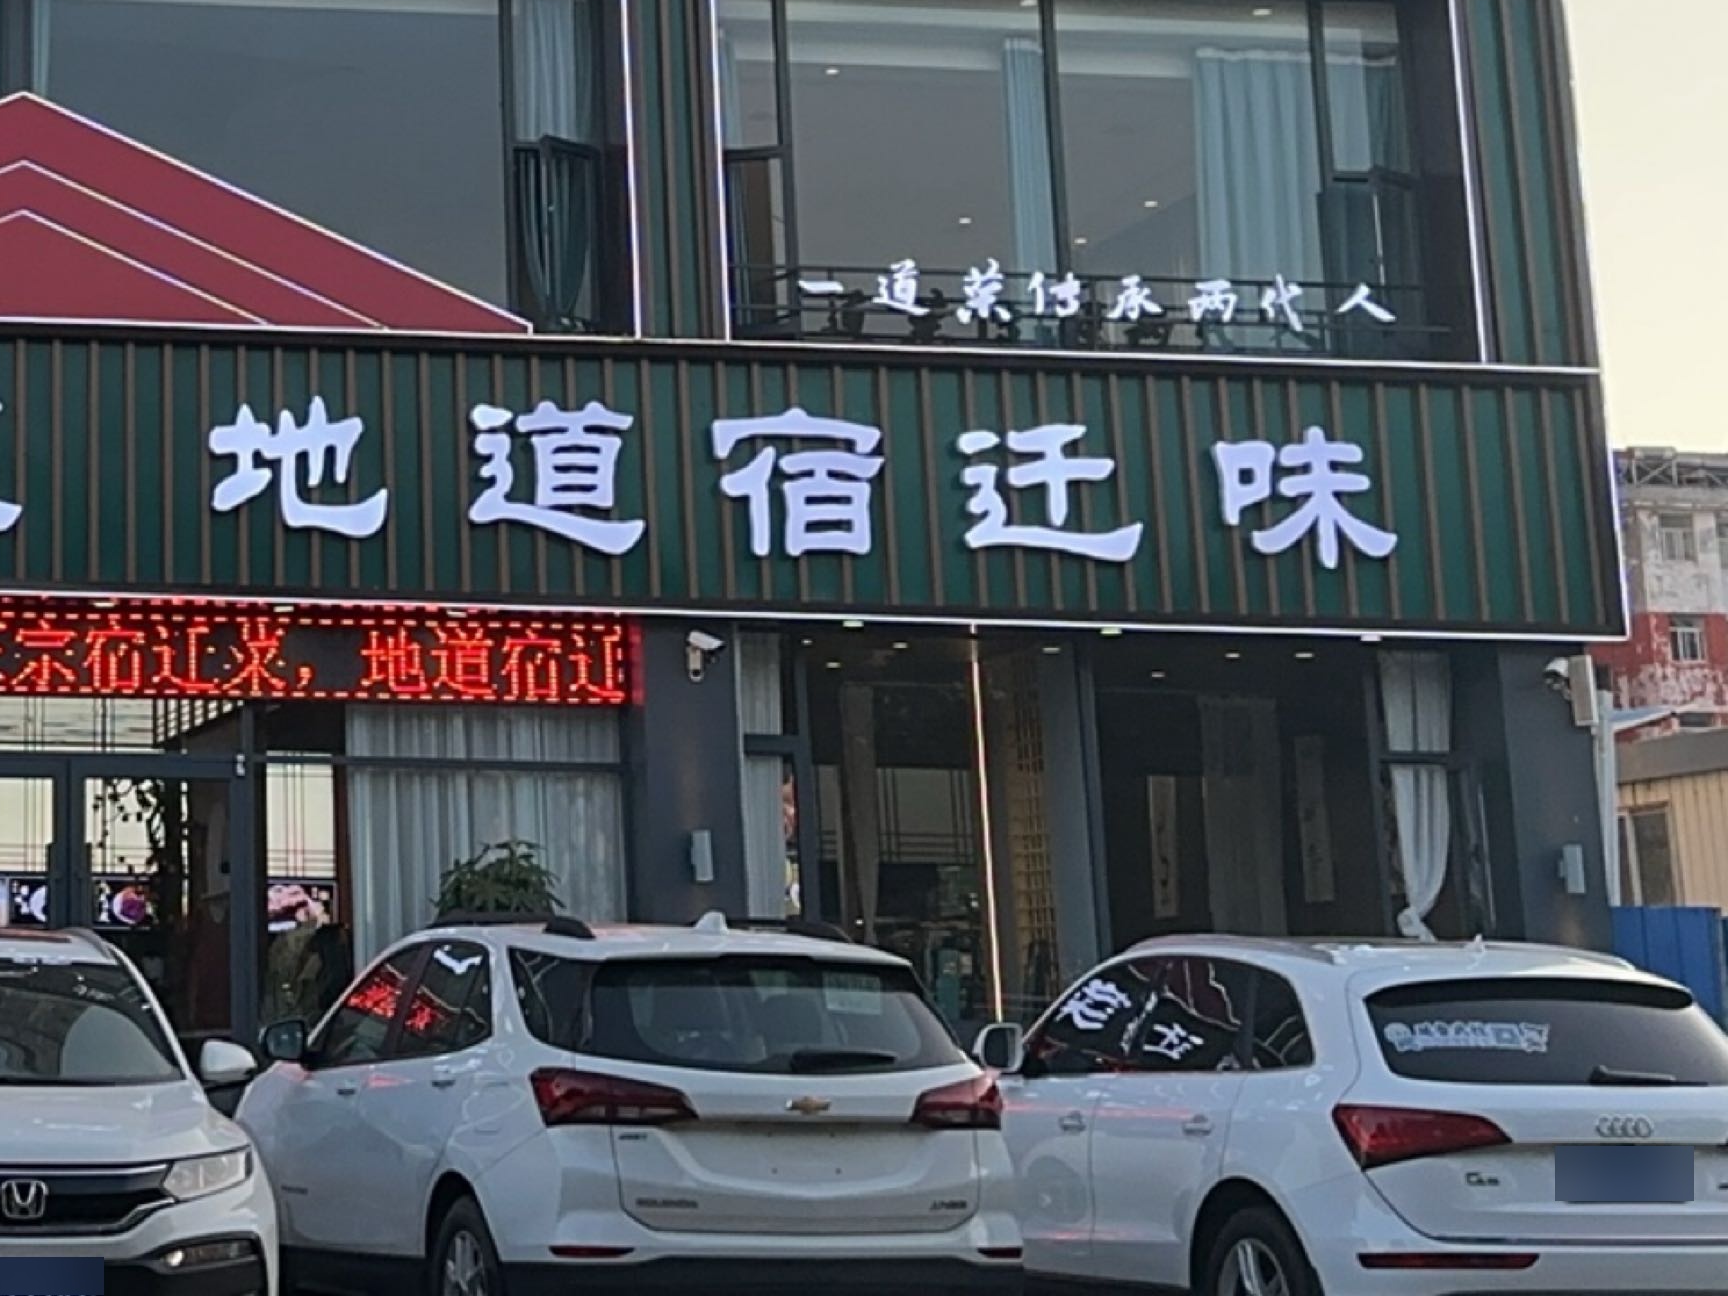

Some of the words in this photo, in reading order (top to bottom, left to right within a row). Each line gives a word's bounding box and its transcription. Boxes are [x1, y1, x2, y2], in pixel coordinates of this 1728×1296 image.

[798, 258, 1396, 332] 一道菜传承两代人
[209, 395, 1397, 568] 地道宿迁味
